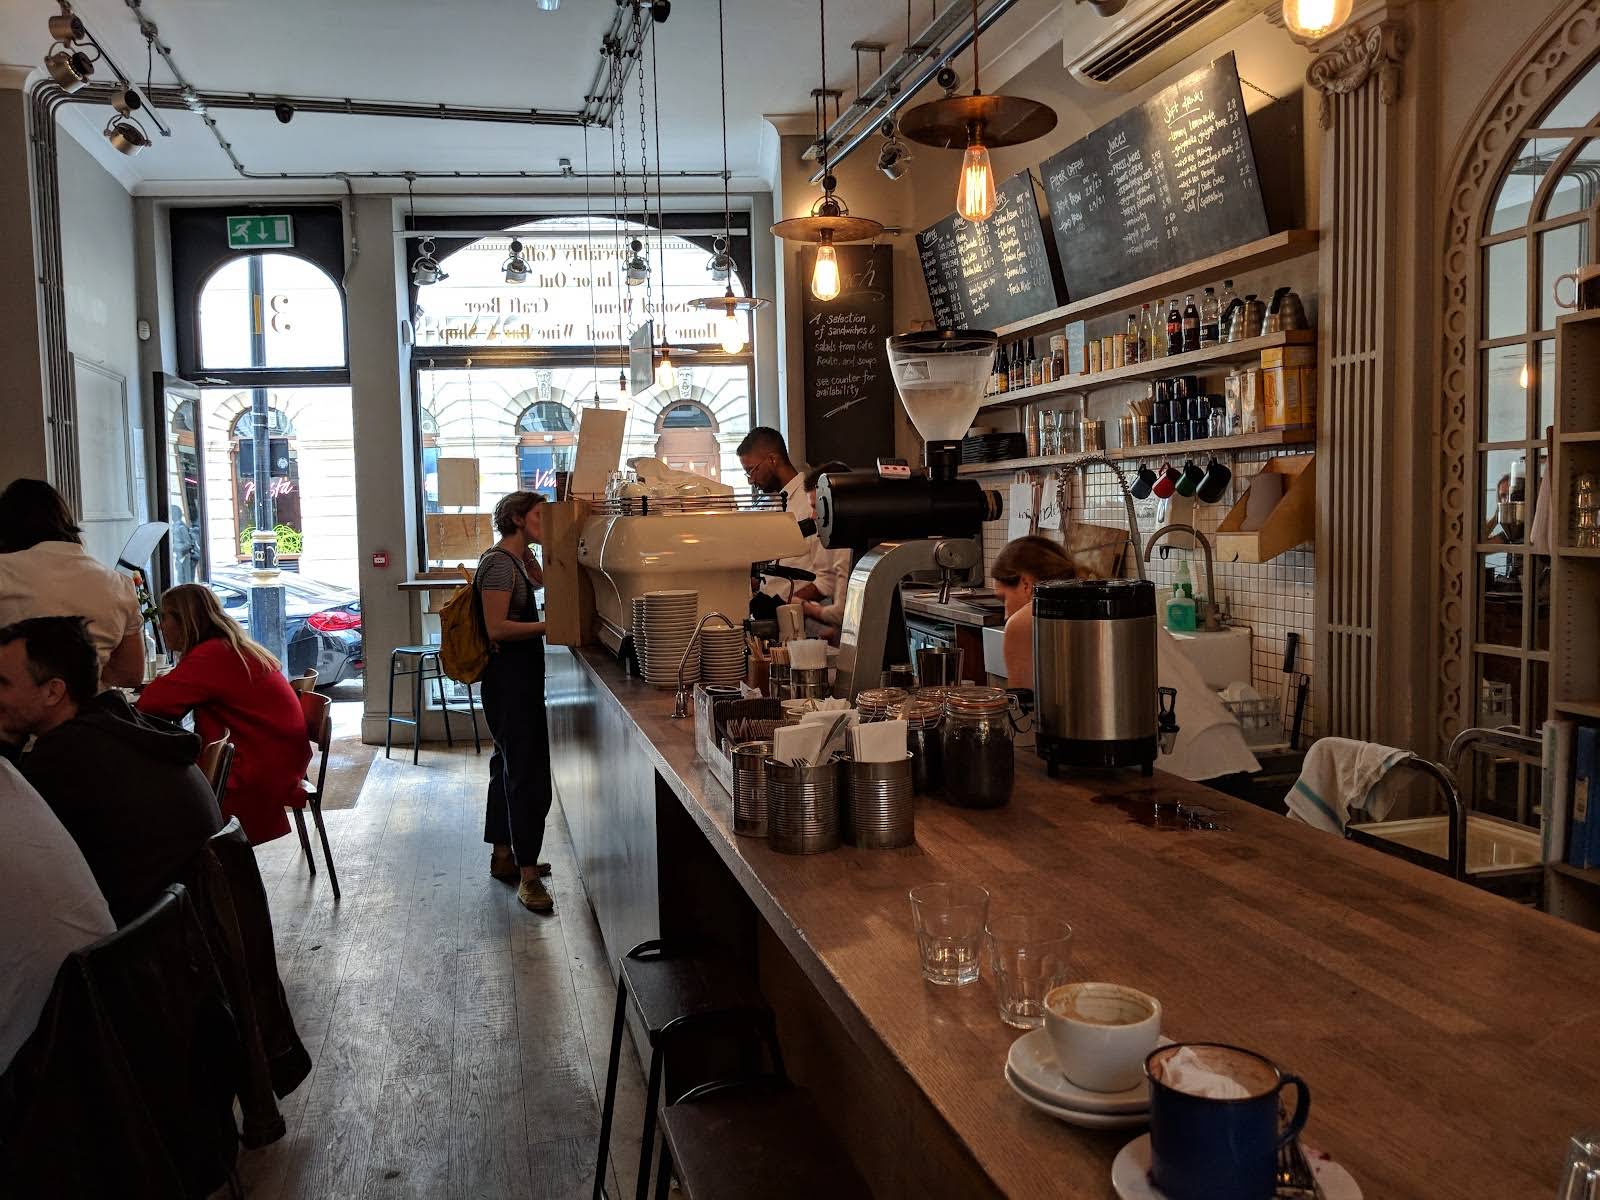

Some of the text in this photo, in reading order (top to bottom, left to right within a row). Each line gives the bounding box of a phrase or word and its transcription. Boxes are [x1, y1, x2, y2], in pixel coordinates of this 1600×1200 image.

[809, 312, 823, 325] A
[815, 325, 826, 340] of
[831, 373, 861, 385] counter
[862, 370, 877, 385] for
[815, 385, 860, 398] availability
[244, 477, 293, 501] Psta
